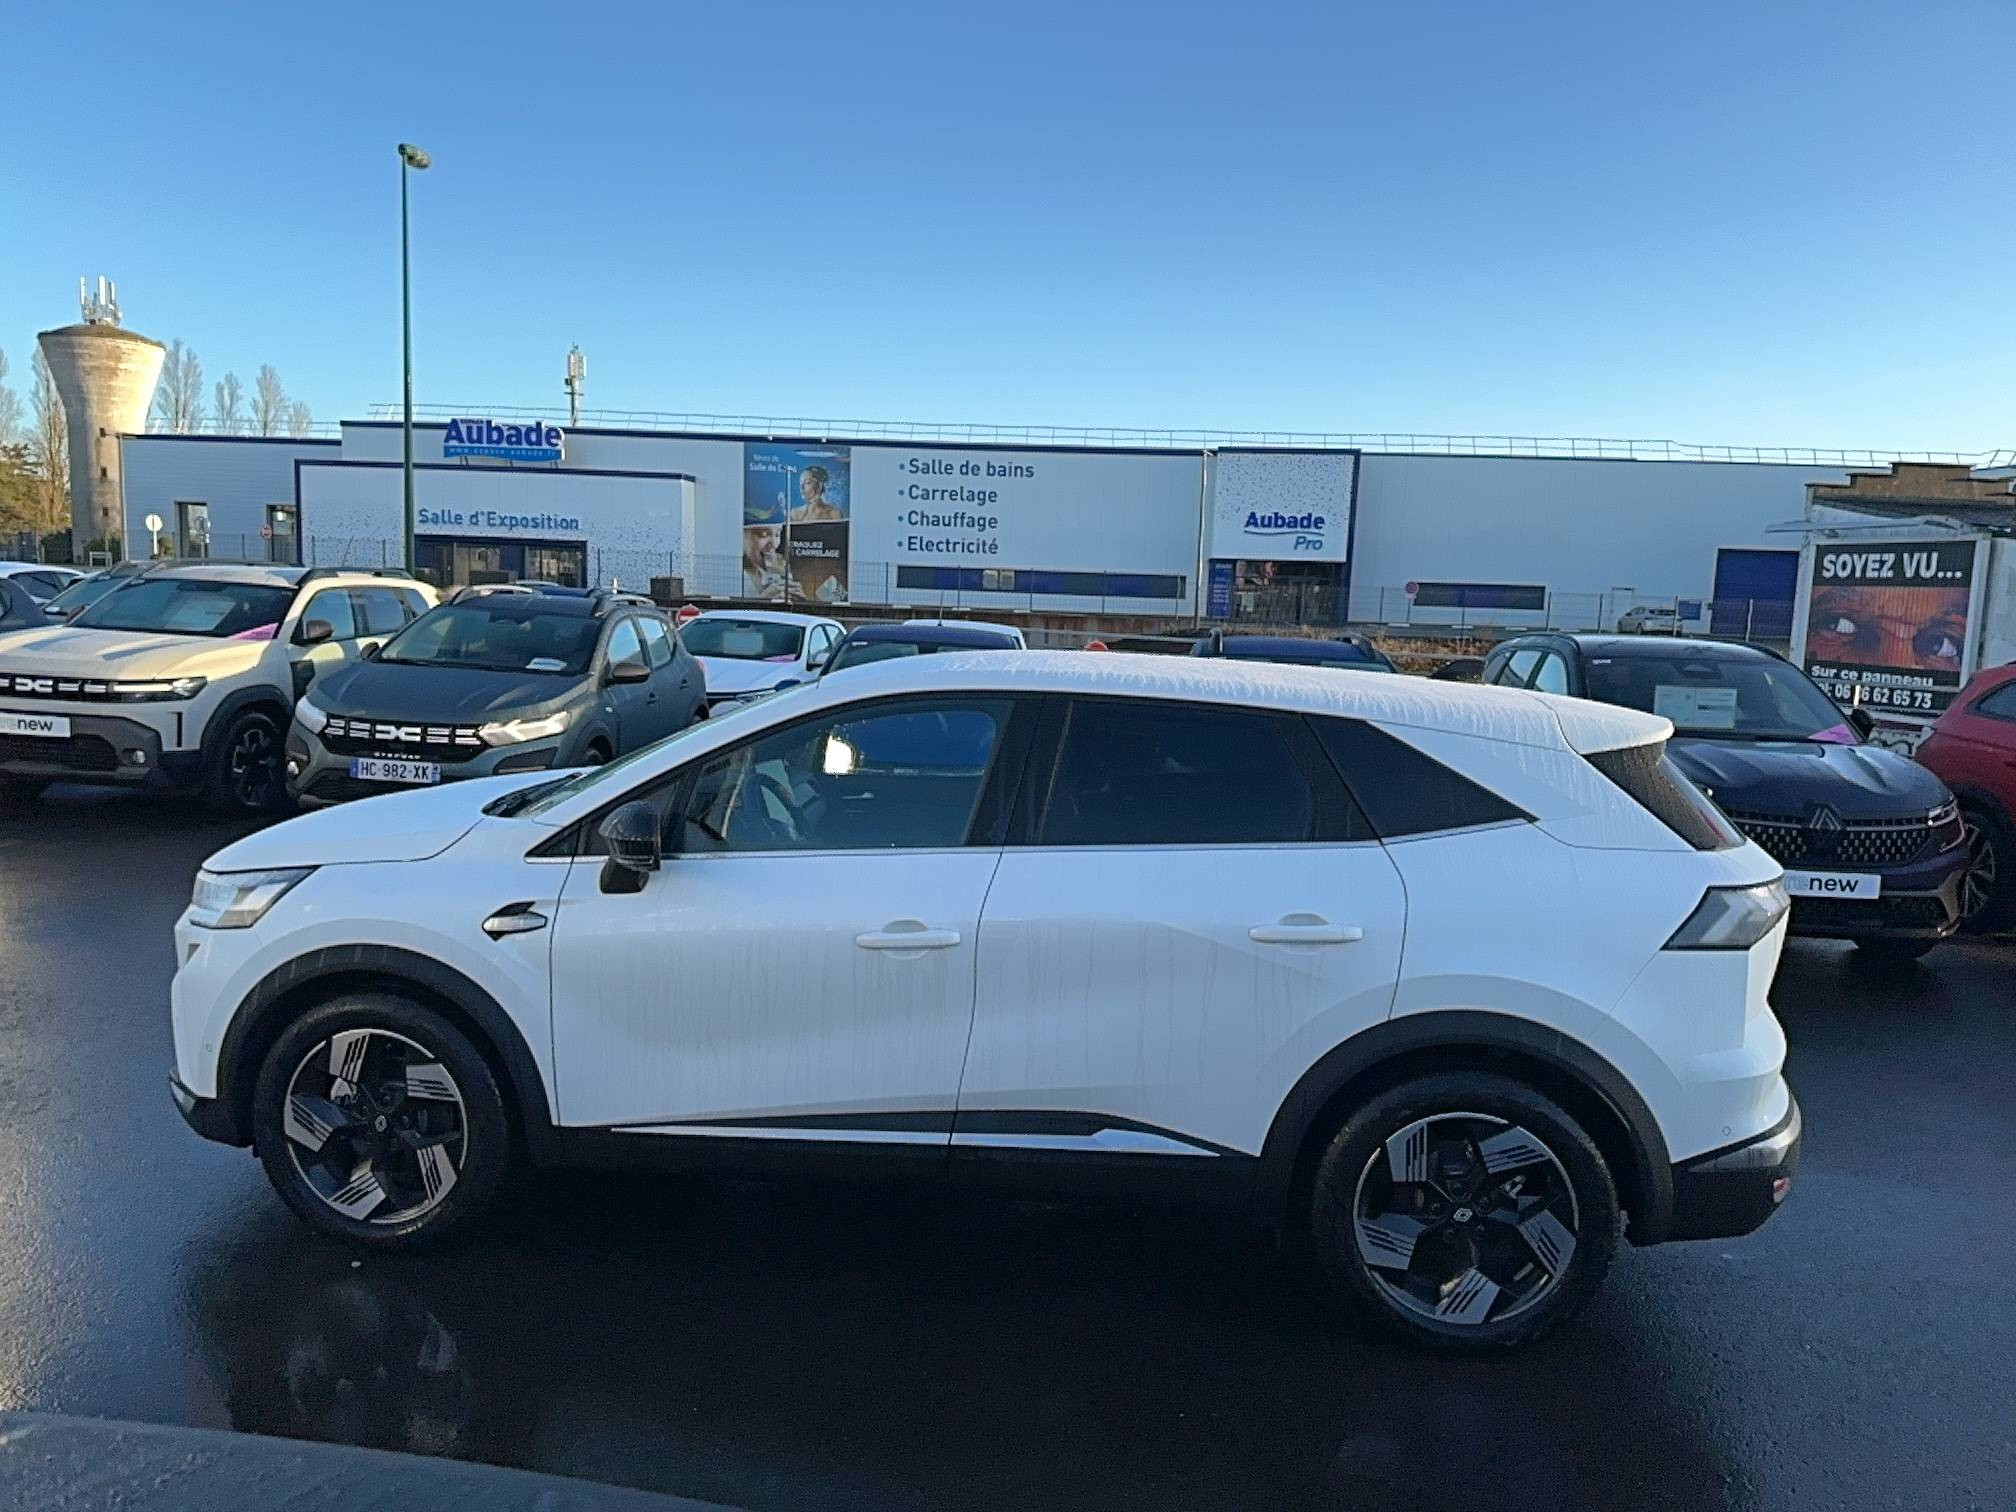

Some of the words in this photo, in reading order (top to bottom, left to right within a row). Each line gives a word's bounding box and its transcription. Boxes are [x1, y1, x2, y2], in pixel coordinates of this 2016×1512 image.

[443, 418, 563, 447] Aubade
[908, 458, 953, 476] Salle
[959, 460, 980, 477] de
[986, 461, 1035, 479] bains
[908, 485, 998, 506] Carrelage
[418, 508, 464, 526] Salle
[469, 510, 580, 531] d'Exposition
[907, 510, 999, 533] Chauffage
[1244, 511, 1326, 530] Aubade
[907, 536, 999, 555] Electricité
[1293, 536, 1324, 551] Pro
[1822, 552, 1896, 578] SOYEZ
[1903, 550, 1963, 579] VU...
[1840, 668, 1858, 681] ce
[1862, 669, 1934, 688] panneau
[1834, 682, 1851, 700] 06
[1873, 687, 1890, 704] 62
[1893, 689, 1911, 706] 65
[1914, 691, 1932, 709] 73
